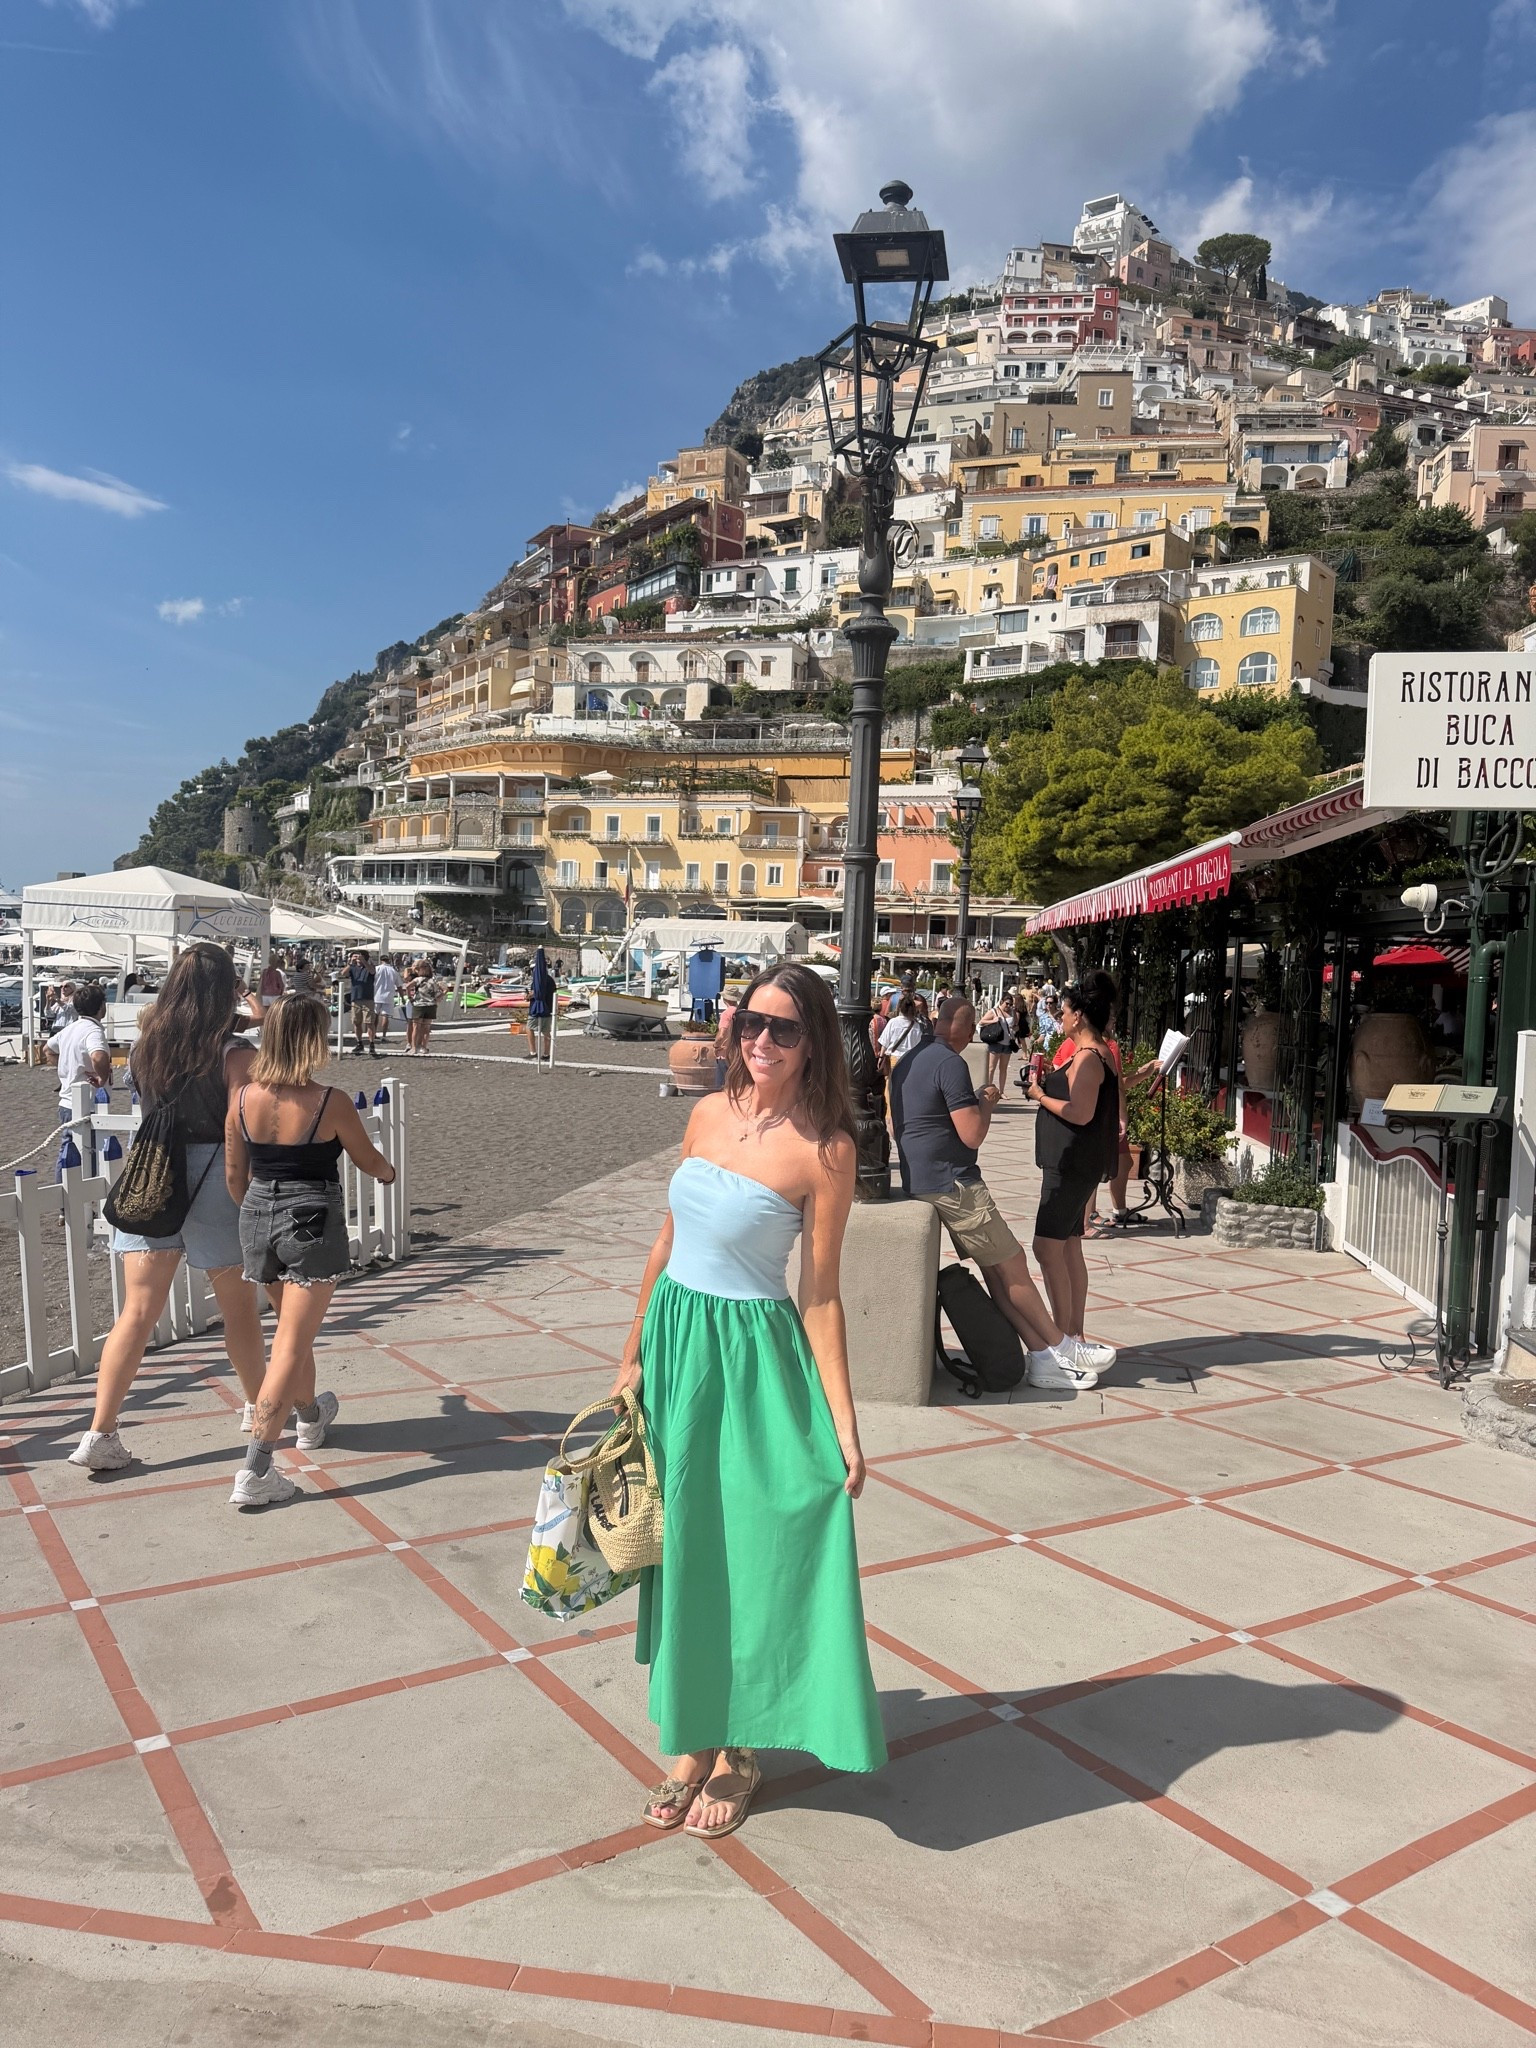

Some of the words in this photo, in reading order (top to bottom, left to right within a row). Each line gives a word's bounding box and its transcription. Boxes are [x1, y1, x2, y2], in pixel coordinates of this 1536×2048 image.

[1400, 671, 1536, 703] RISTORAN
[1445, 714, 1515, 746] BUCA
[1416, 757, 1440, 789] DI
[1457, 757, 1536, 789] BACCO
[1183, 866, 1193, 890] LA
[212, 916, 266, 927] LUCIBELLO
